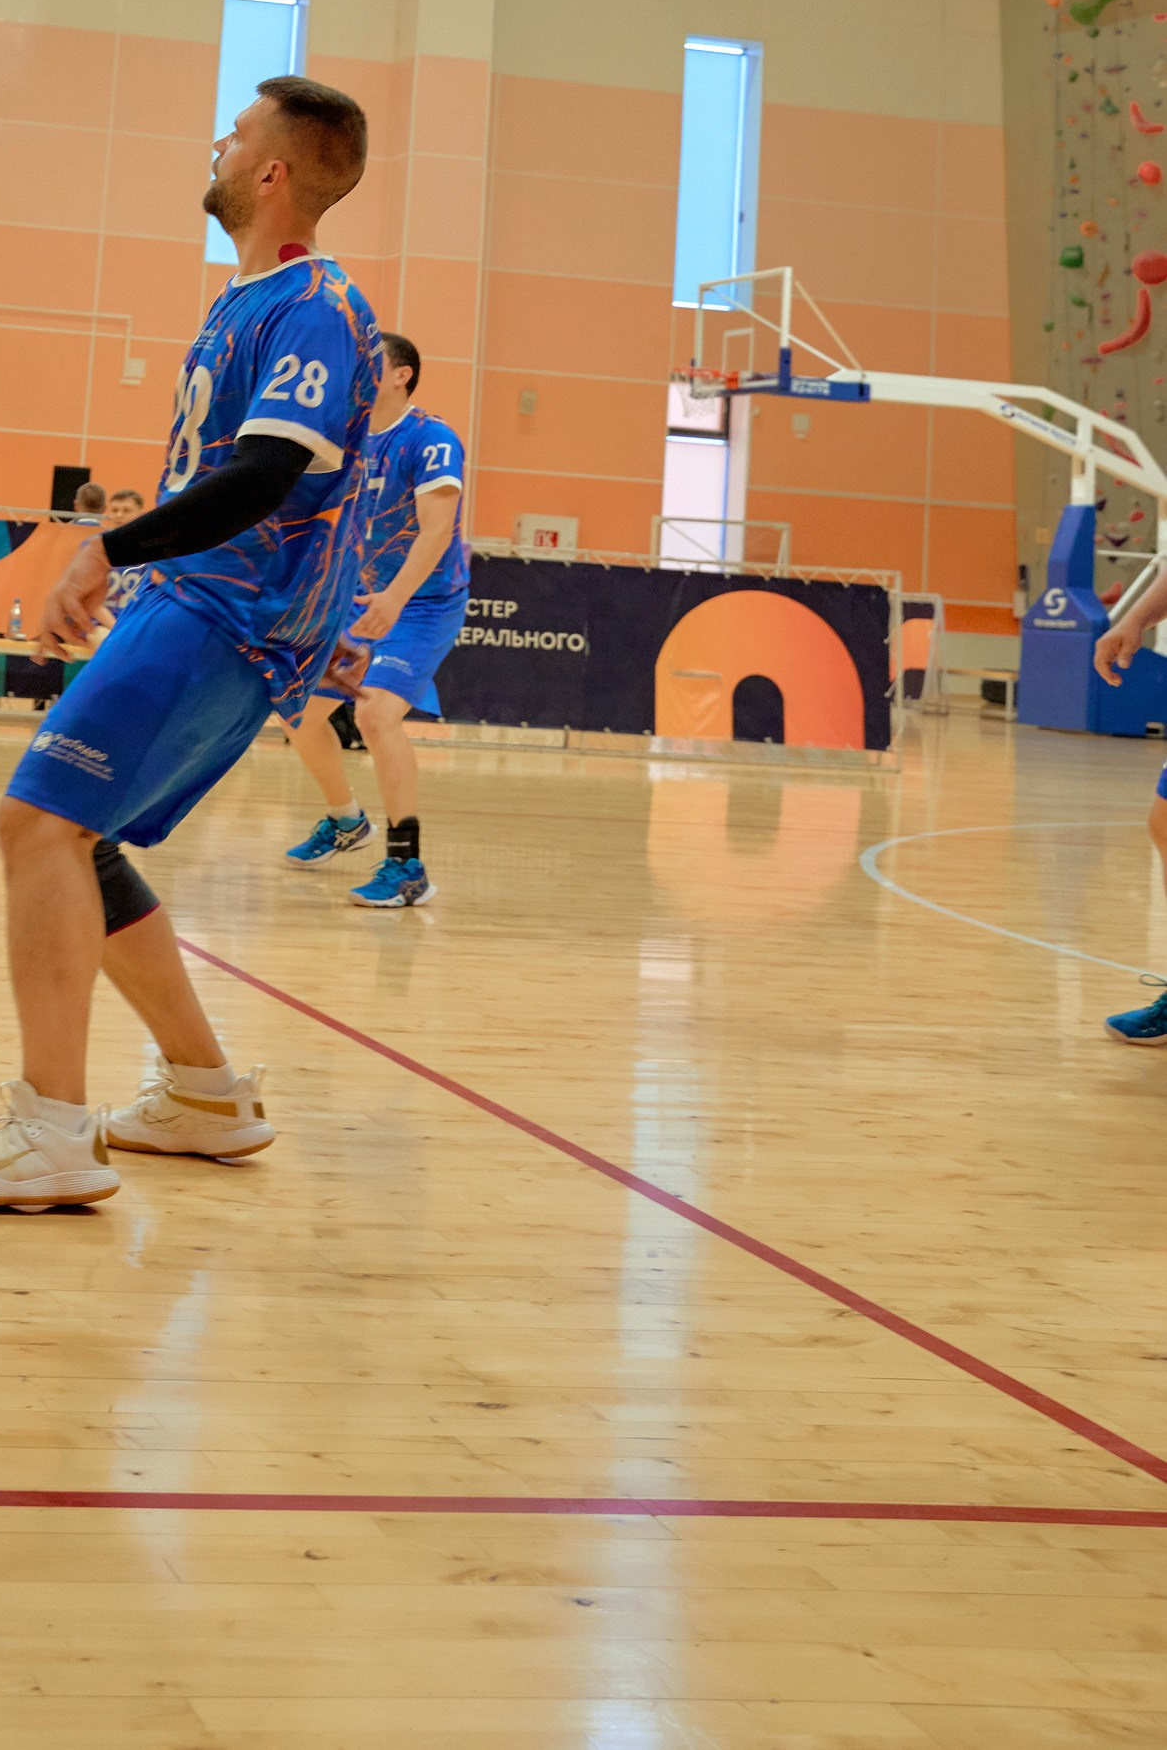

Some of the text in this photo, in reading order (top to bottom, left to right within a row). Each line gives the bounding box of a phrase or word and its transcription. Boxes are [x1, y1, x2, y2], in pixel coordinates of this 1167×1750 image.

[261, 353, 329, 408] 28
[423, 442, 452, 471] 27
[465, 597, 519, 619] СТЕР
[454, 626, 586, 653] ЕРАЛЬНОГО
